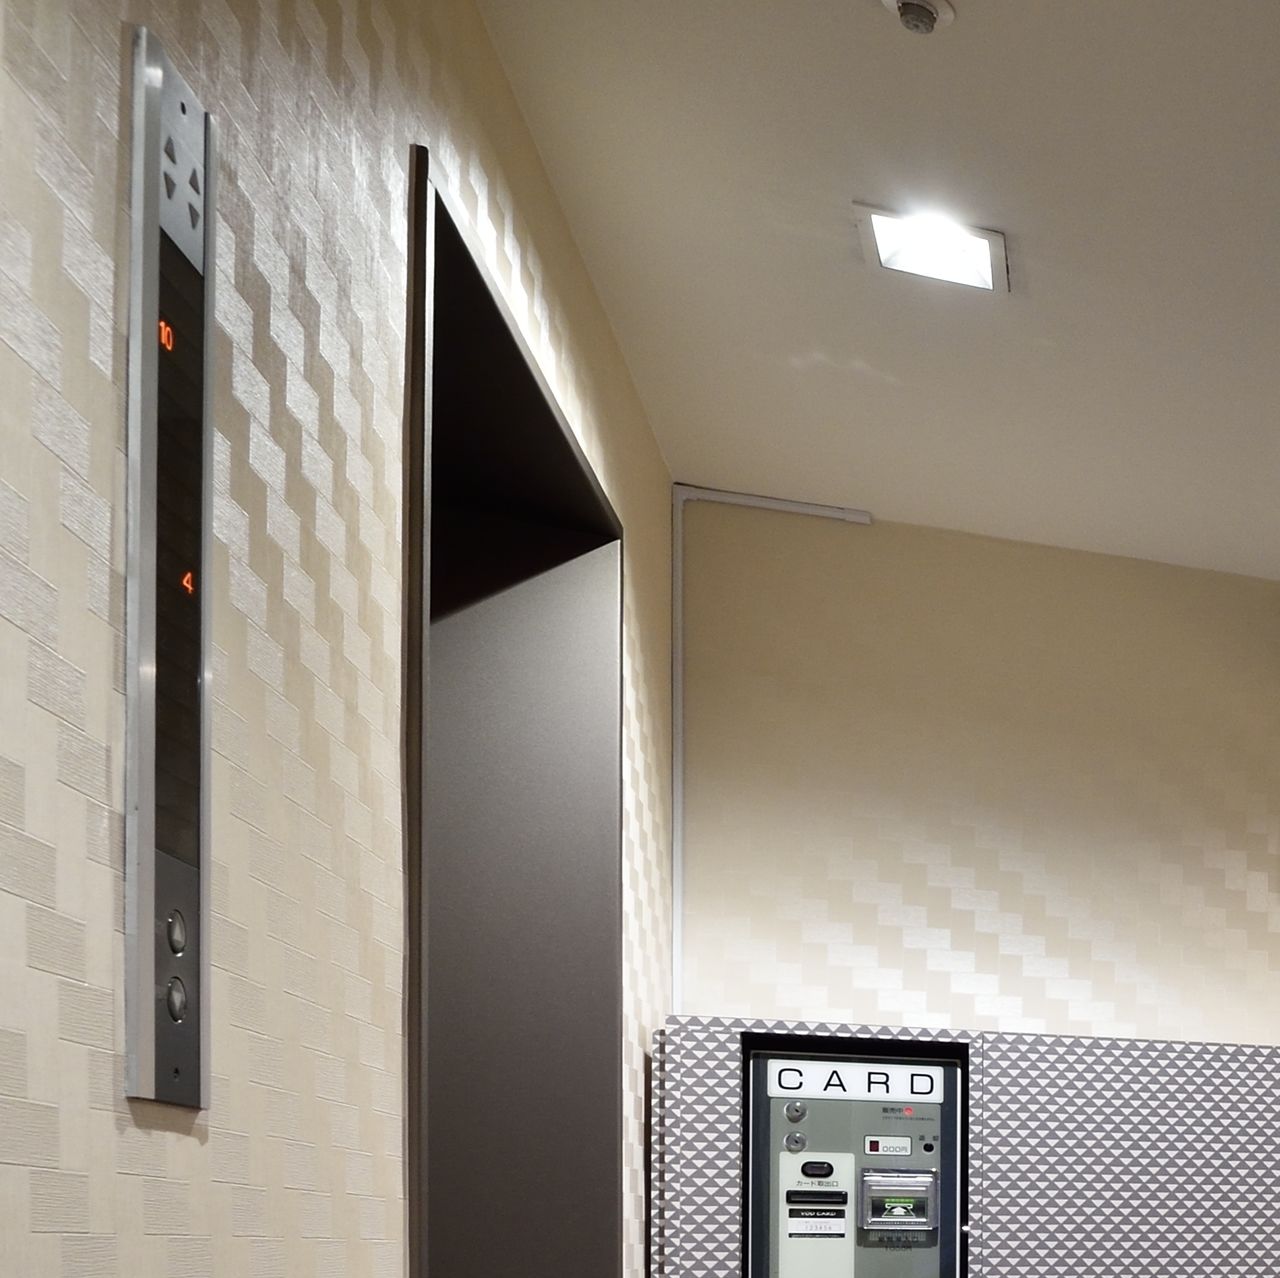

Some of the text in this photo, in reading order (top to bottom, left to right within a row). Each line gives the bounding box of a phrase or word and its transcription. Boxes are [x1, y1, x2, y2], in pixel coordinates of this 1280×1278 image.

[159, 320, 173, 350] 10
[182, 571, 194, 594] 4
[777, 1067, 935, 1096] CARD
